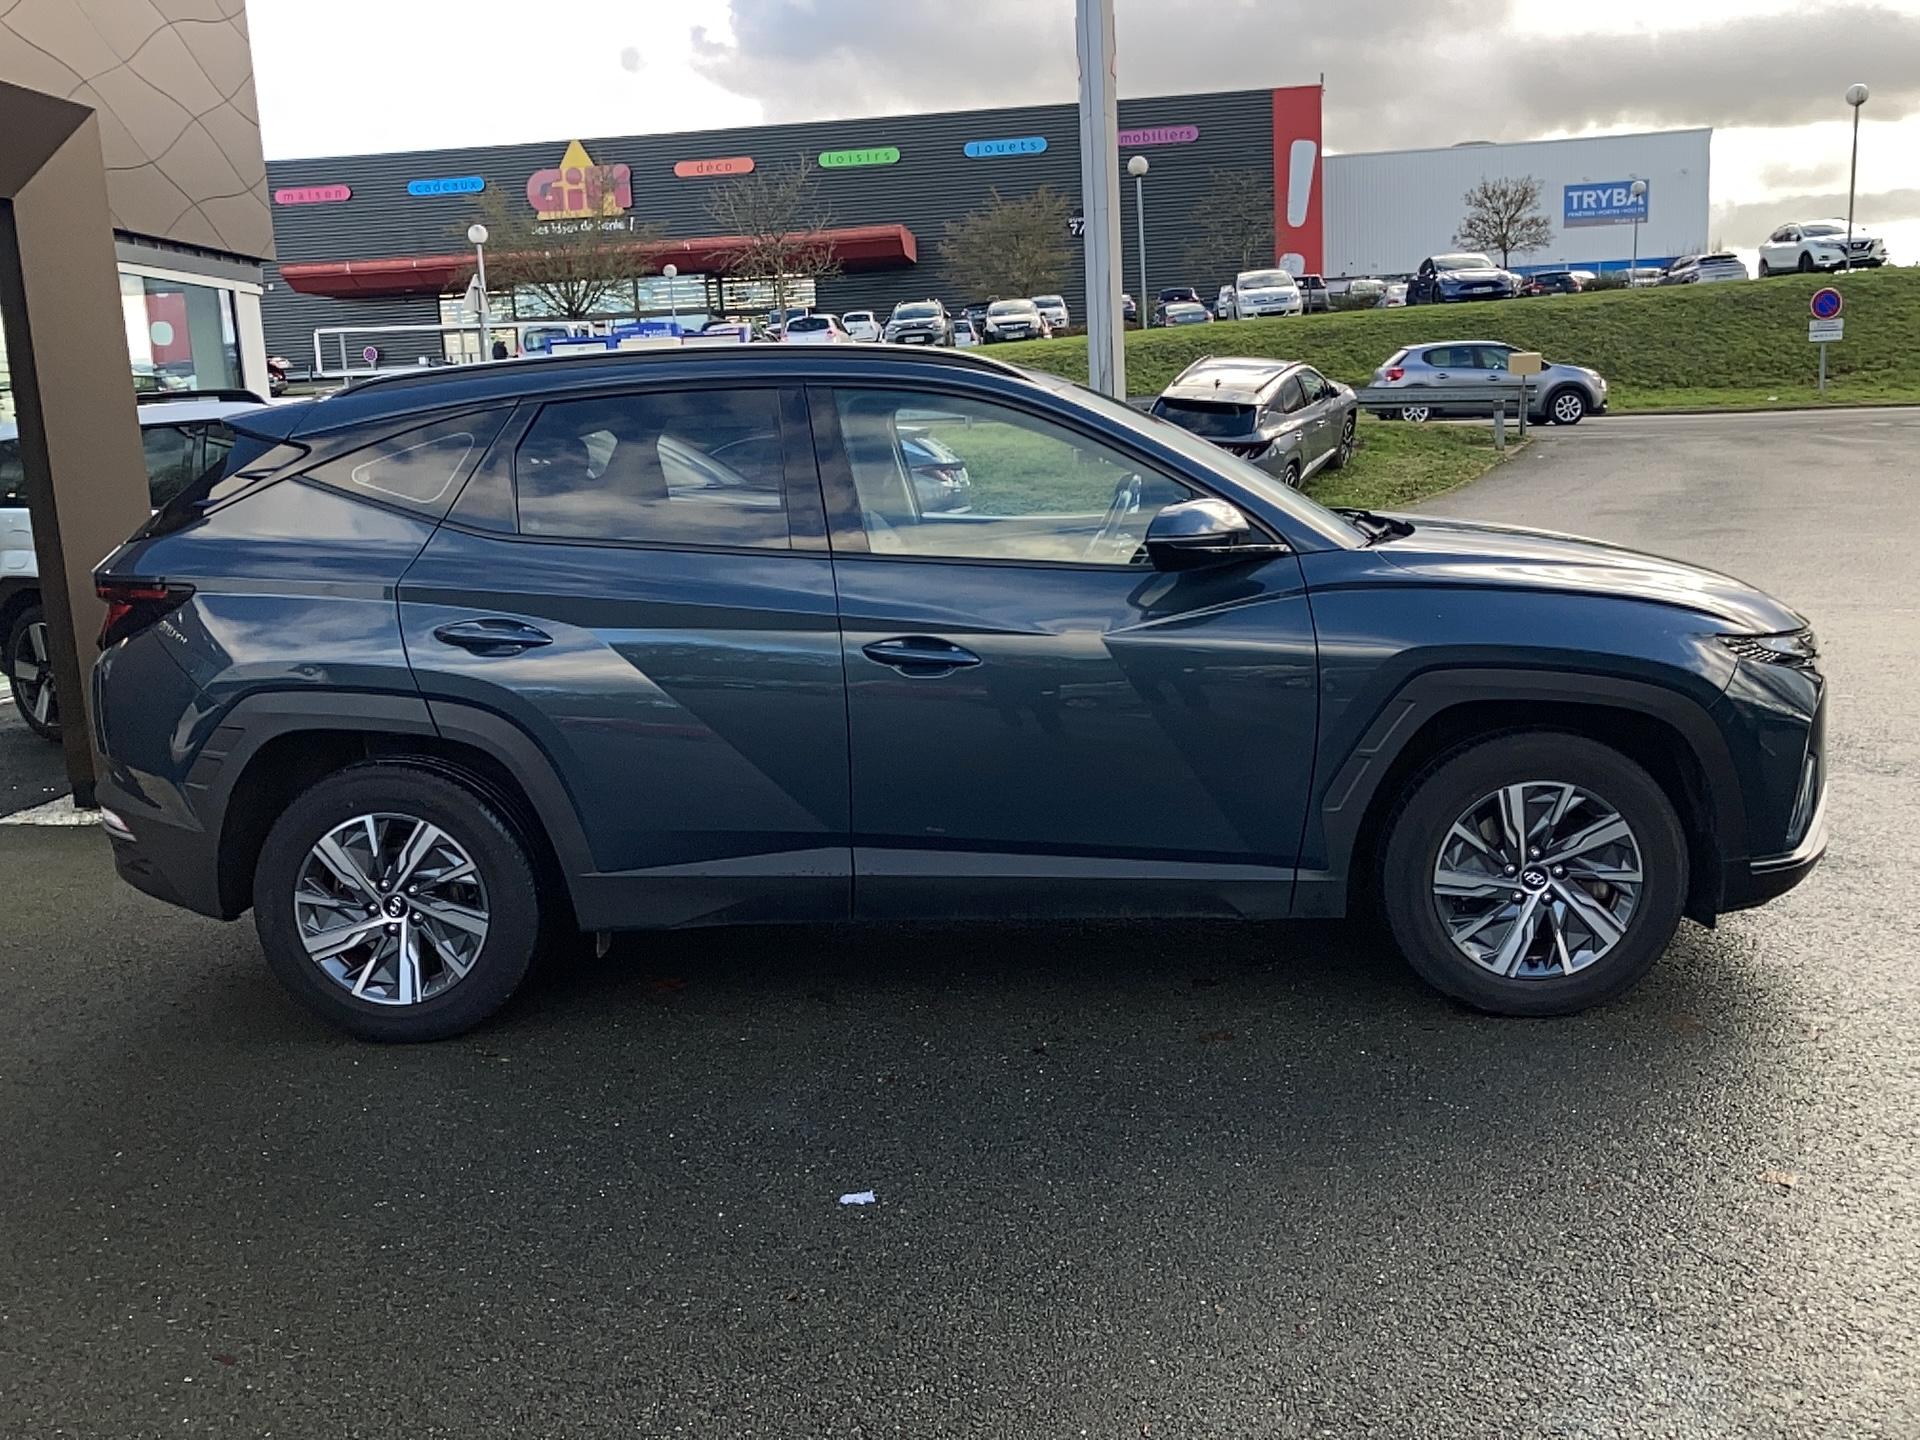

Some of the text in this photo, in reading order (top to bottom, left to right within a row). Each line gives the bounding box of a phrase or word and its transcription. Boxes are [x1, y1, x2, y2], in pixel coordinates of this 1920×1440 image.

[1120, 130, 1193, 143] mobiliers
[976, 141, 1037, 155] jouets
[828, 152, 890, 164] loisirs
[415, 181, 477, 193] cadeaux
[283, 190, 342, 201] maison
[1567, 188, 1644, 210] TRYBA
